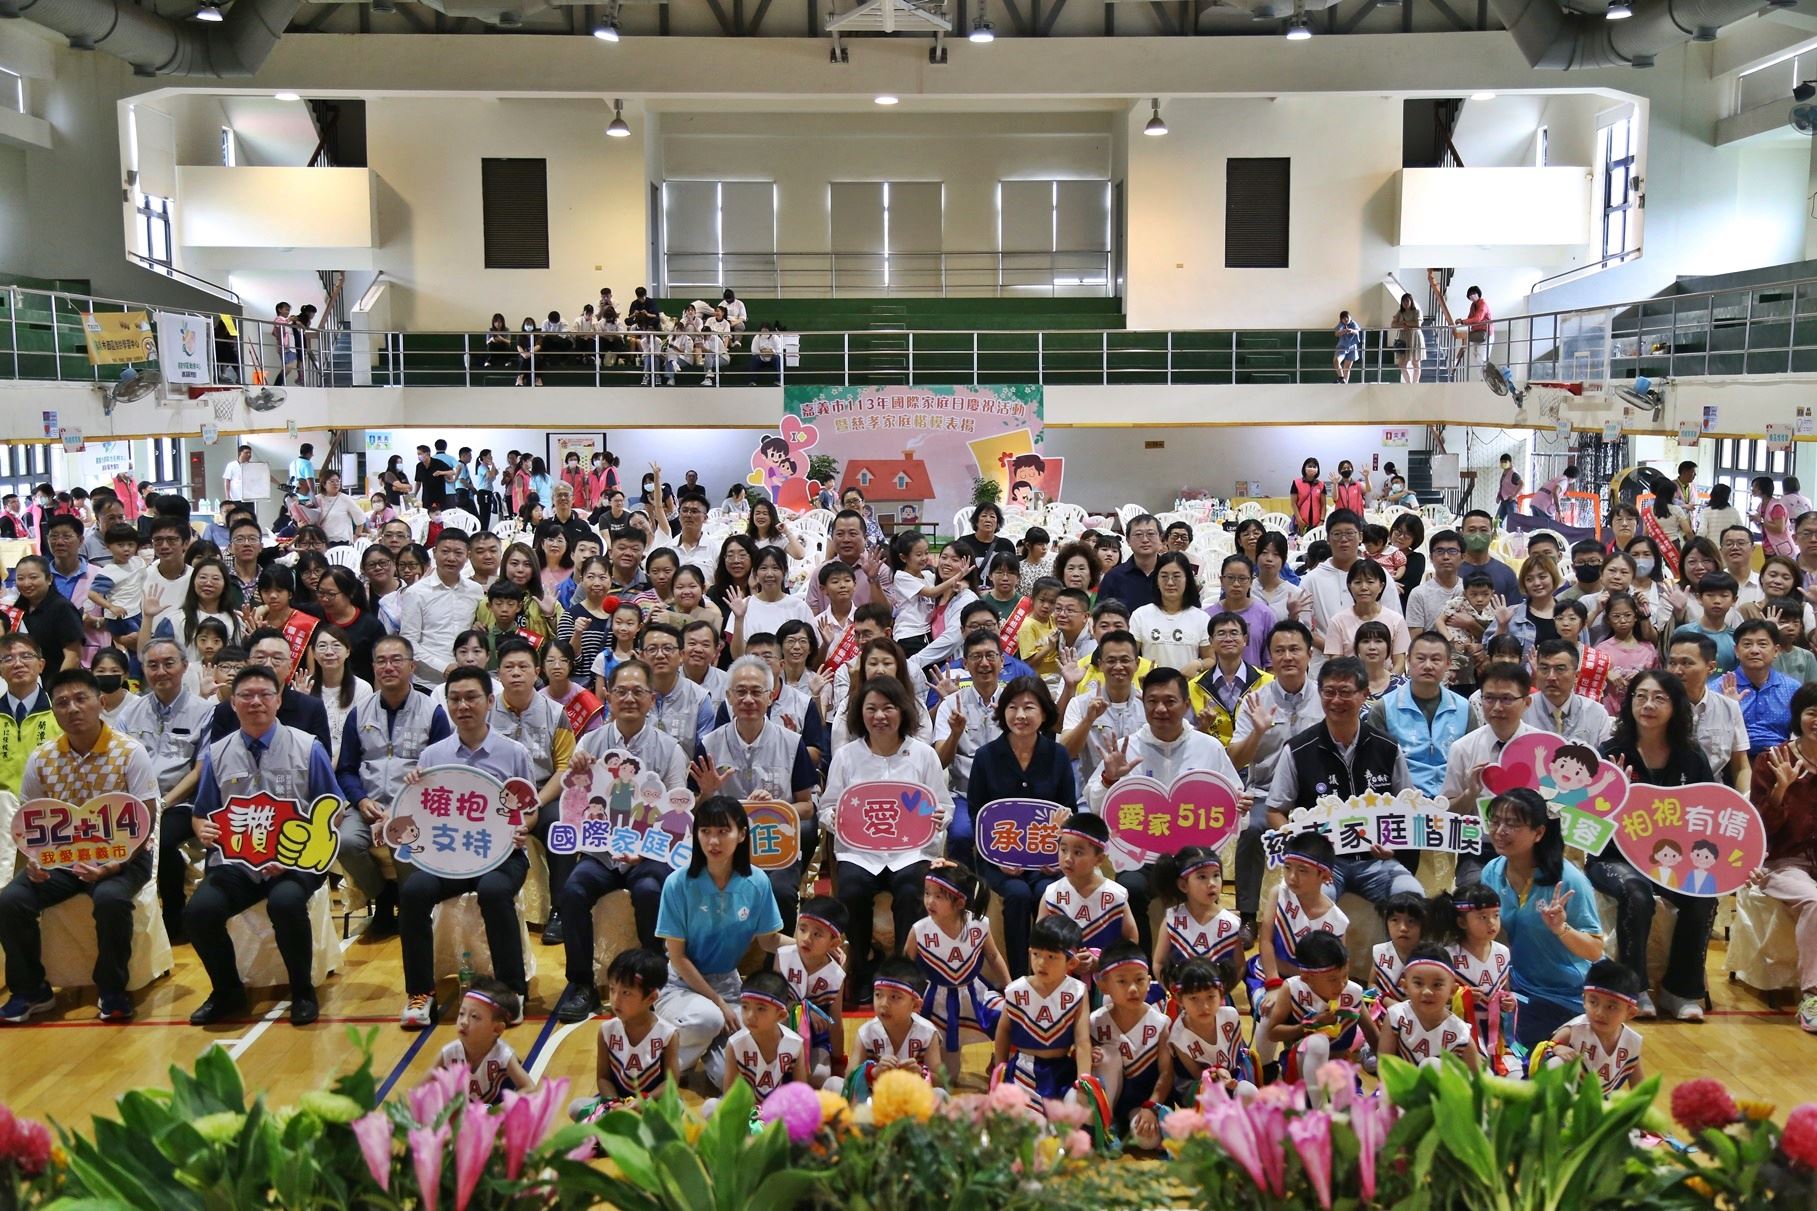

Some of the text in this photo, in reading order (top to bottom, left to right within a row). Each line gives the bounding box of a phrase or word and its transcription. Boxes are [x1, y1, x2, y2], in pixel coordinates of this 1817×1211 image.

[800, 394, 1026, 418] 嘉義市113年國際家庭日慶祝活動
[834, 414, 976, 433] 暨慈孝家庭楷模表揚
[420, 786, 489, 823] 擁抱
[862, 798, 900, 838] 愛
[1622, 798, 1750, 841] 相視有情
[22, 801, 141, 847] 52+14
[227, 804, 276, 854] 讚
[430, 823, 493, 859] 支持
[990, 820, 1060, 855] 承諾
[40, 843, 129, 865] 我愛嘉義市
